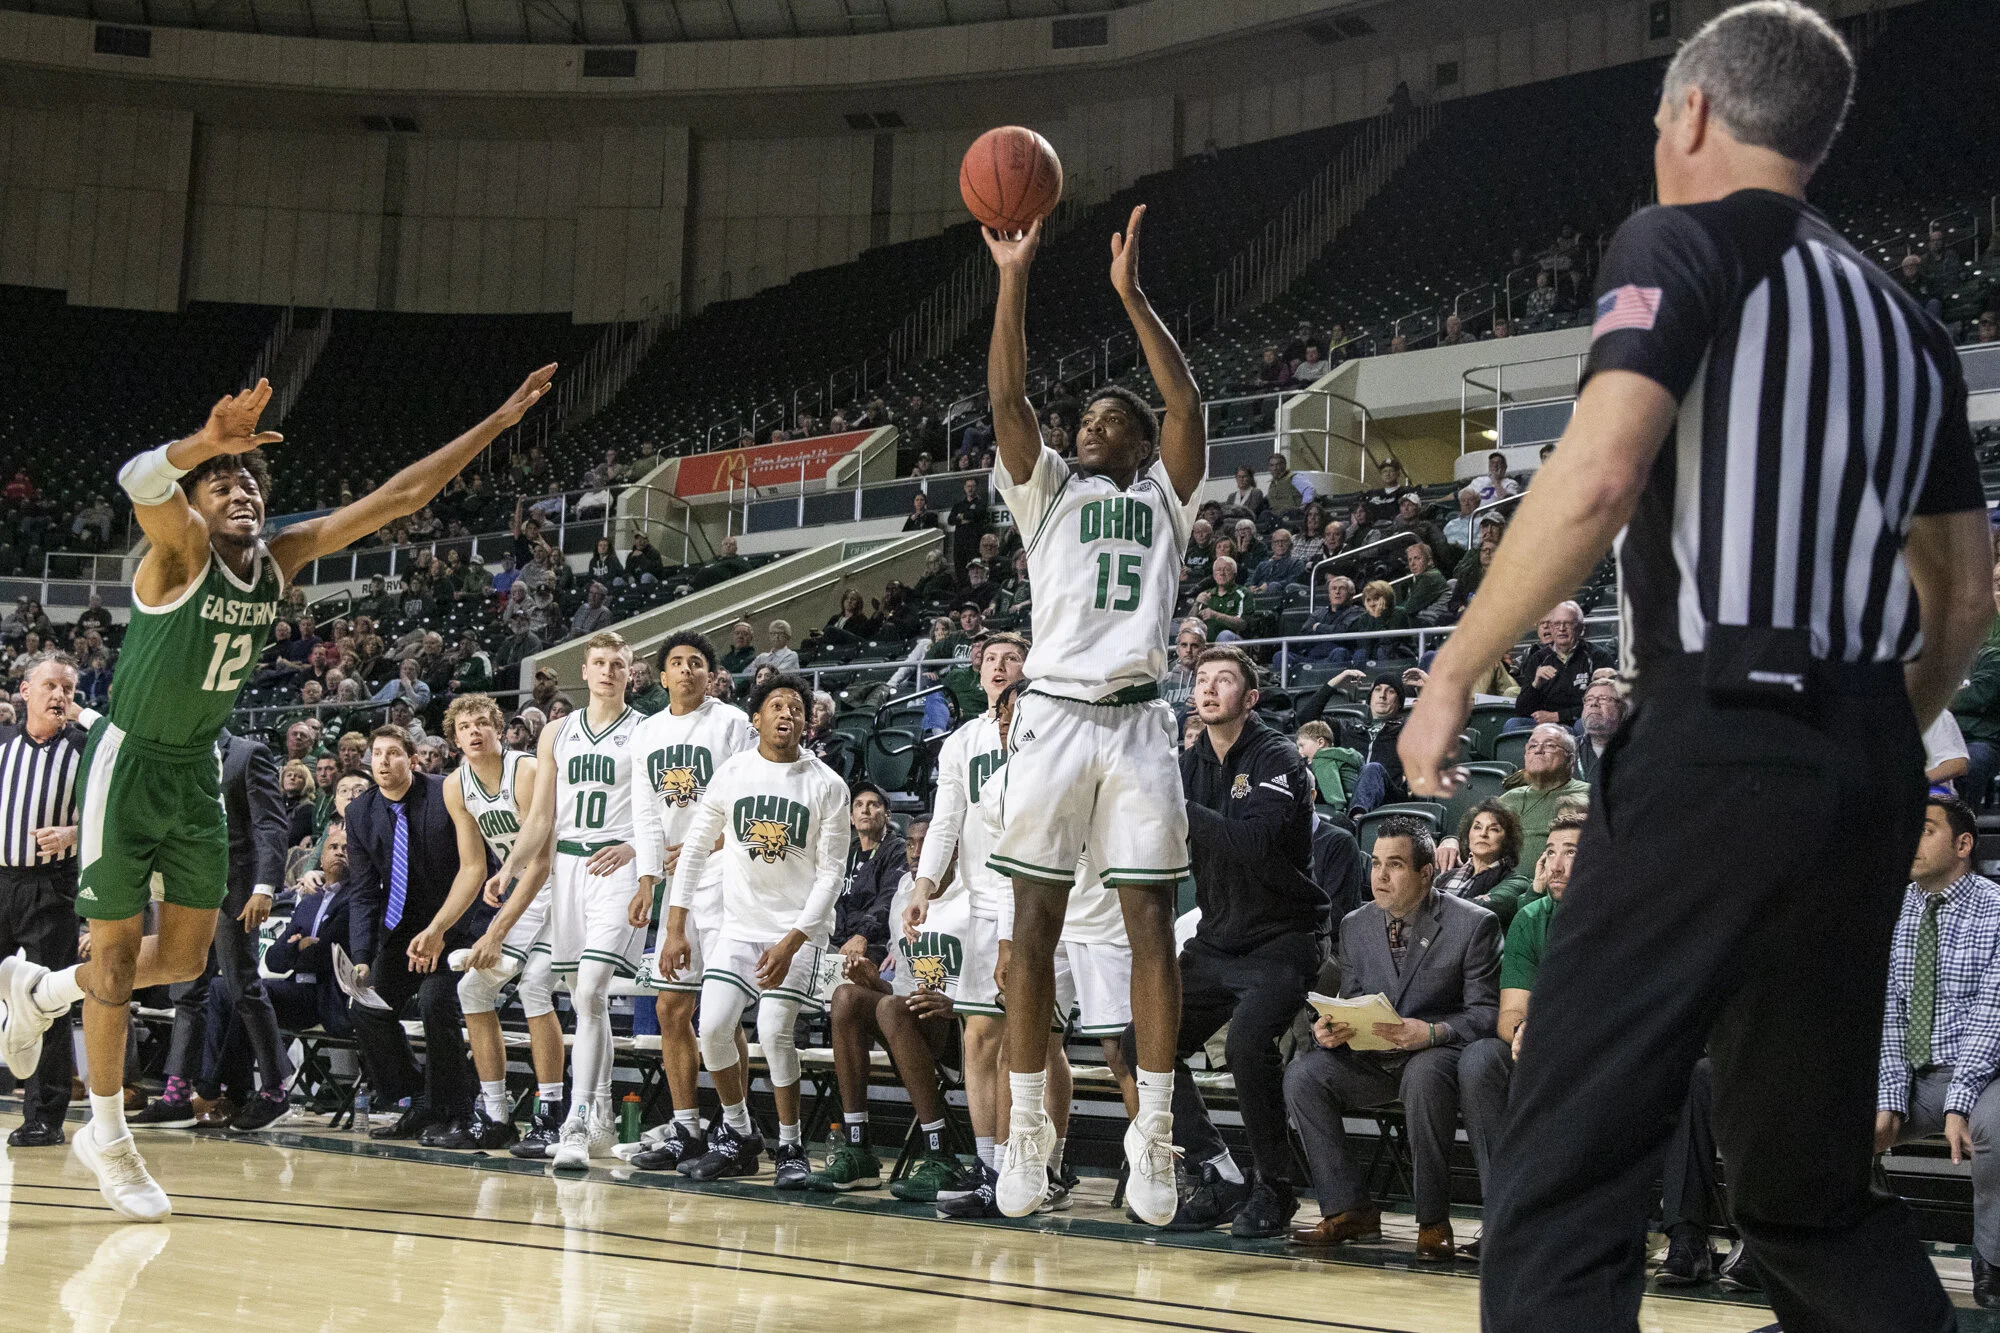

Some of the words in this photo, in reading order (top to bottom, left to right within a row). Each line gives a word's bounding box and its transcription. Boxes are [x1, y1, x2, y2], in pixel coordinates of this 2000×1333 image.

[1080, 496, 1153, 549] OHIO
[1095, 552, 1142, 612] 15
[200, 594, 277, 626] EASTERN
[201, 632, 253, 692] 12
[568, 753, 616, 786] OHIO
[647, 743, 714, 793] OHIO
[478, 810, 521, 839] OHIO
[575, 790, 608, 829] 10
[734, 795, 810, 848] OHIO
[898, 931, 963, 977] OHIO
